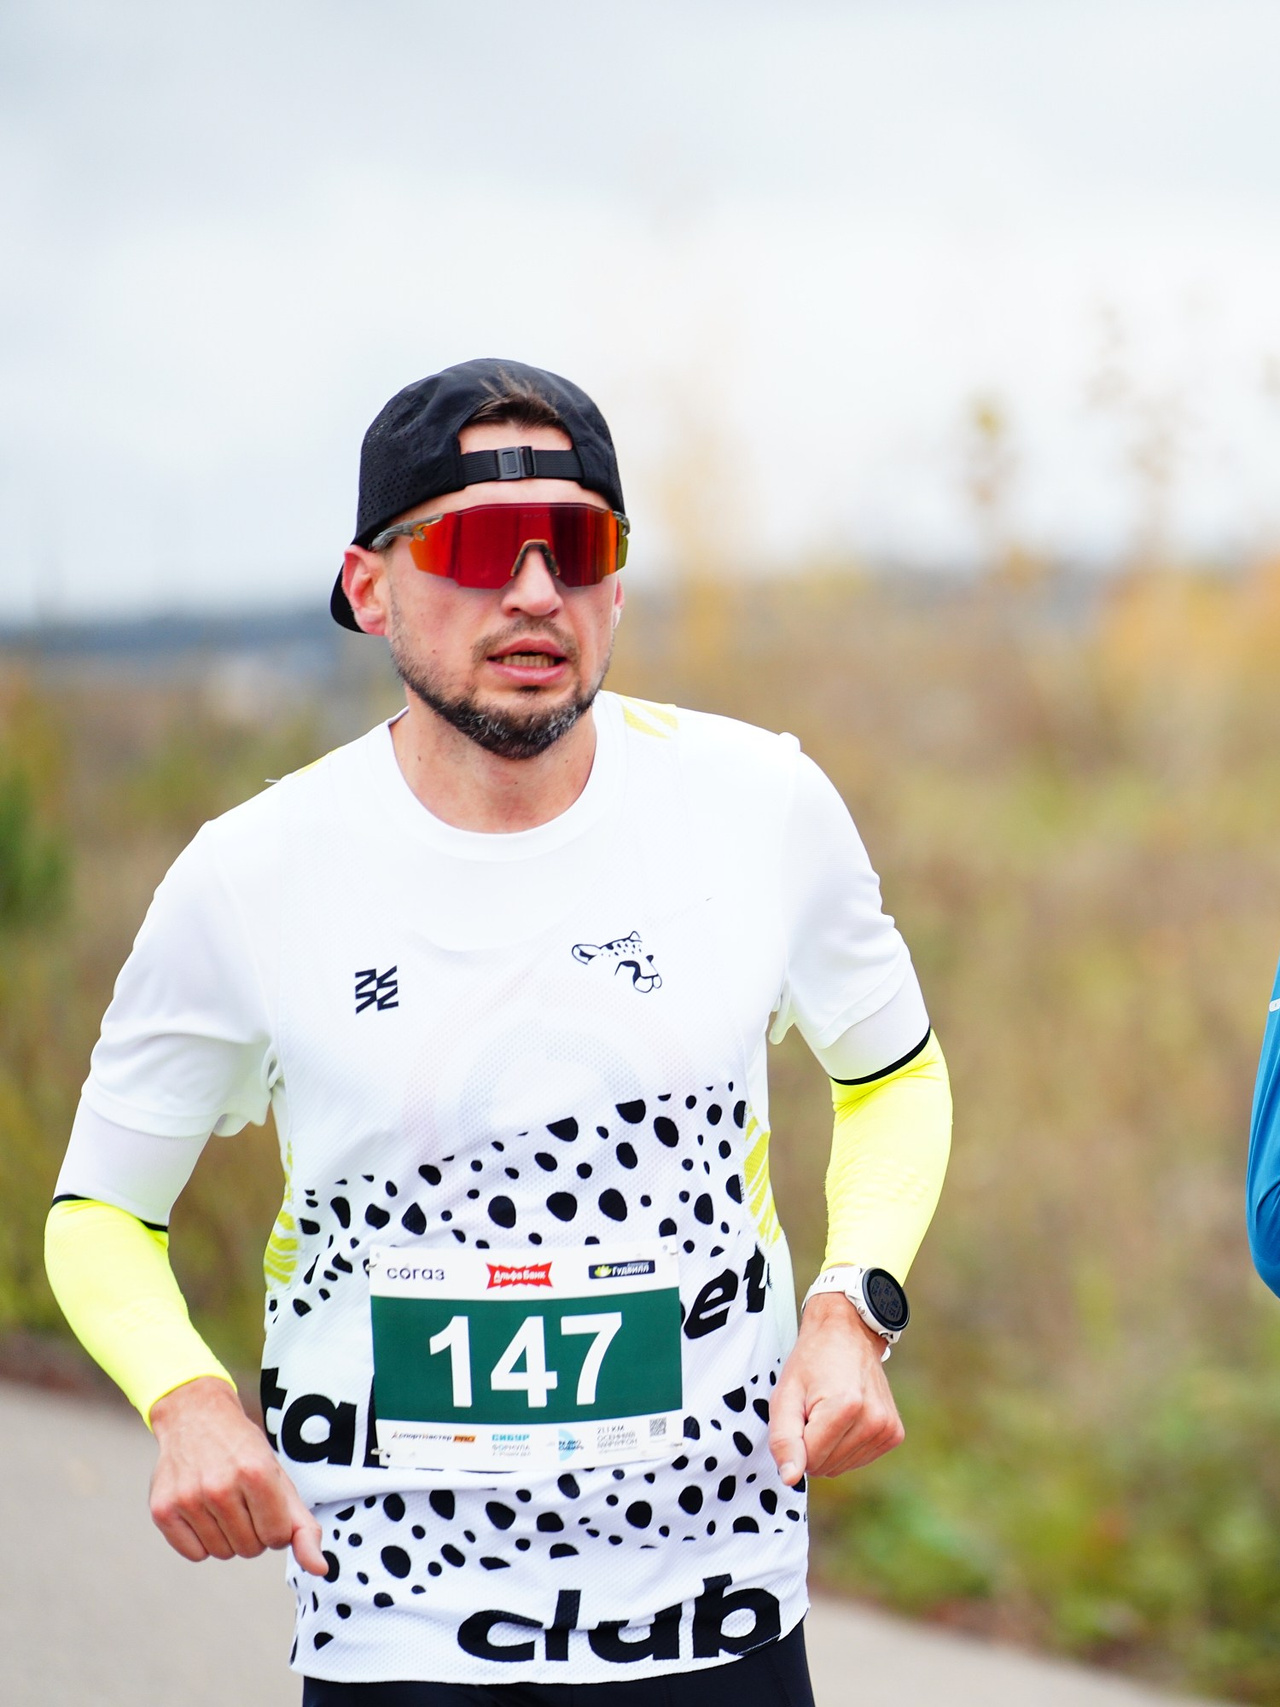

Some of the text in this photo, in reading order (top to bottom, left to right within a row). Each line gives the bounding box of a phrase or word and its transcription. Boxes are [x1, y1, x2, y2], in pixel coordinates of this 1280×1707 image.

[493, 1269, 546, 1283] Альфа Банк
[429, 1311, 623, 1409] 147
[491, 1433, 530, 1442] СИБУР
[457, 1572, 782, 1664] club
